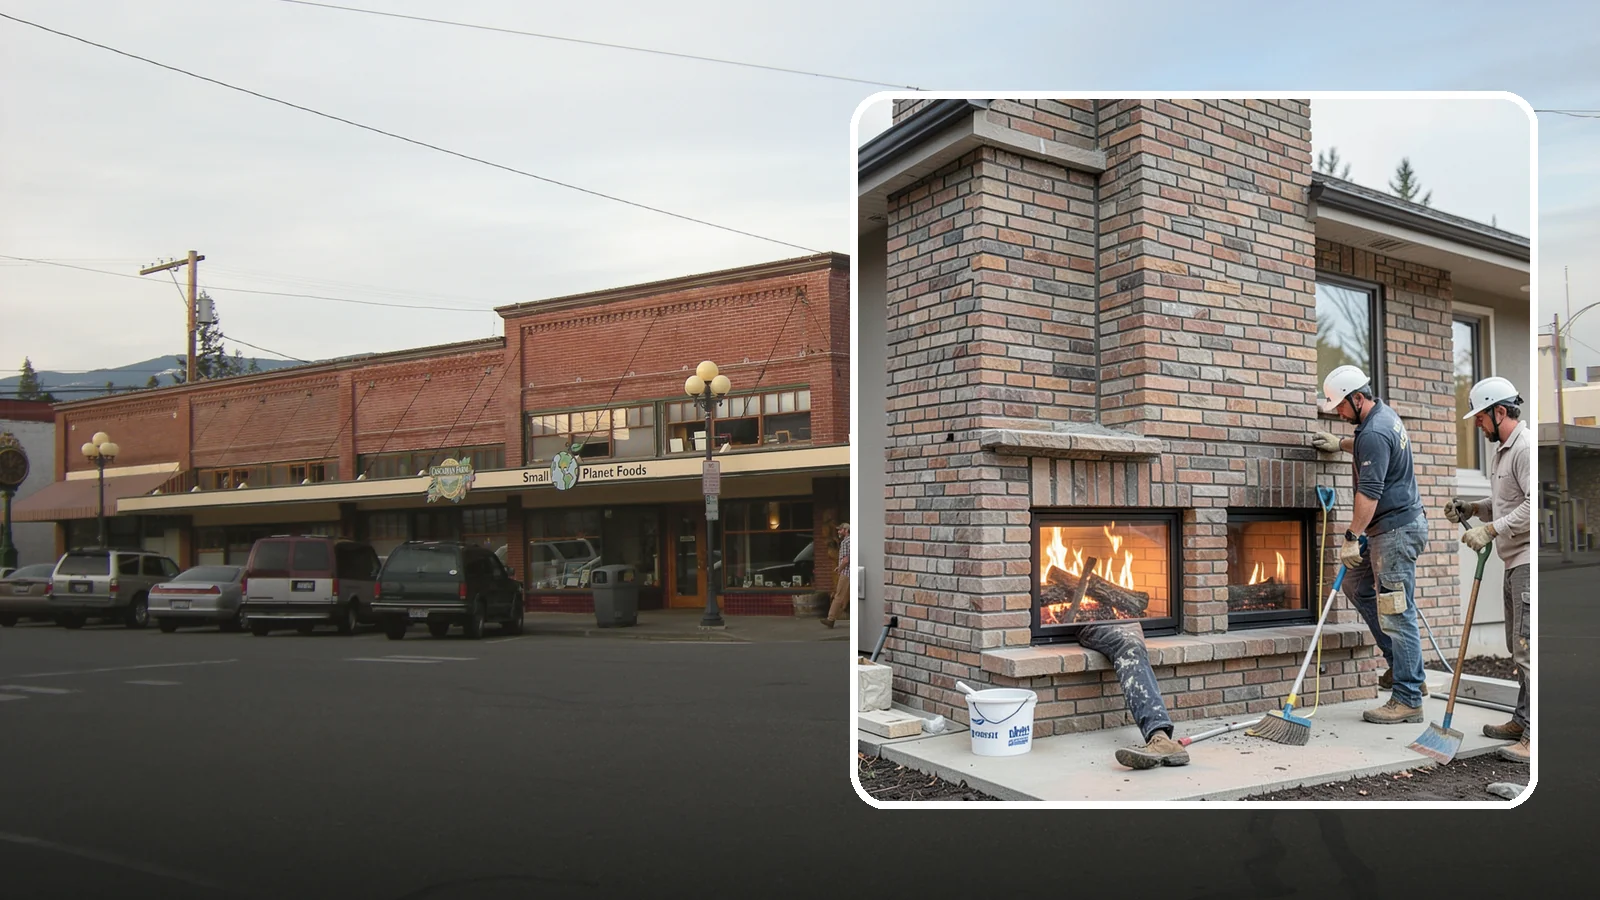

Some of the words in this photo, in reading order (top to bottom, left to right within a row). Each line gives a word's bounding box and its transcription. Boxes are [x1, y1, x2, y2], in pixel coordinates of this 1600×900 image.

[523, 471, 549, 483] Small
[582, 468, 614, 480] Planet
[616, 464, 647, 477] Foods
